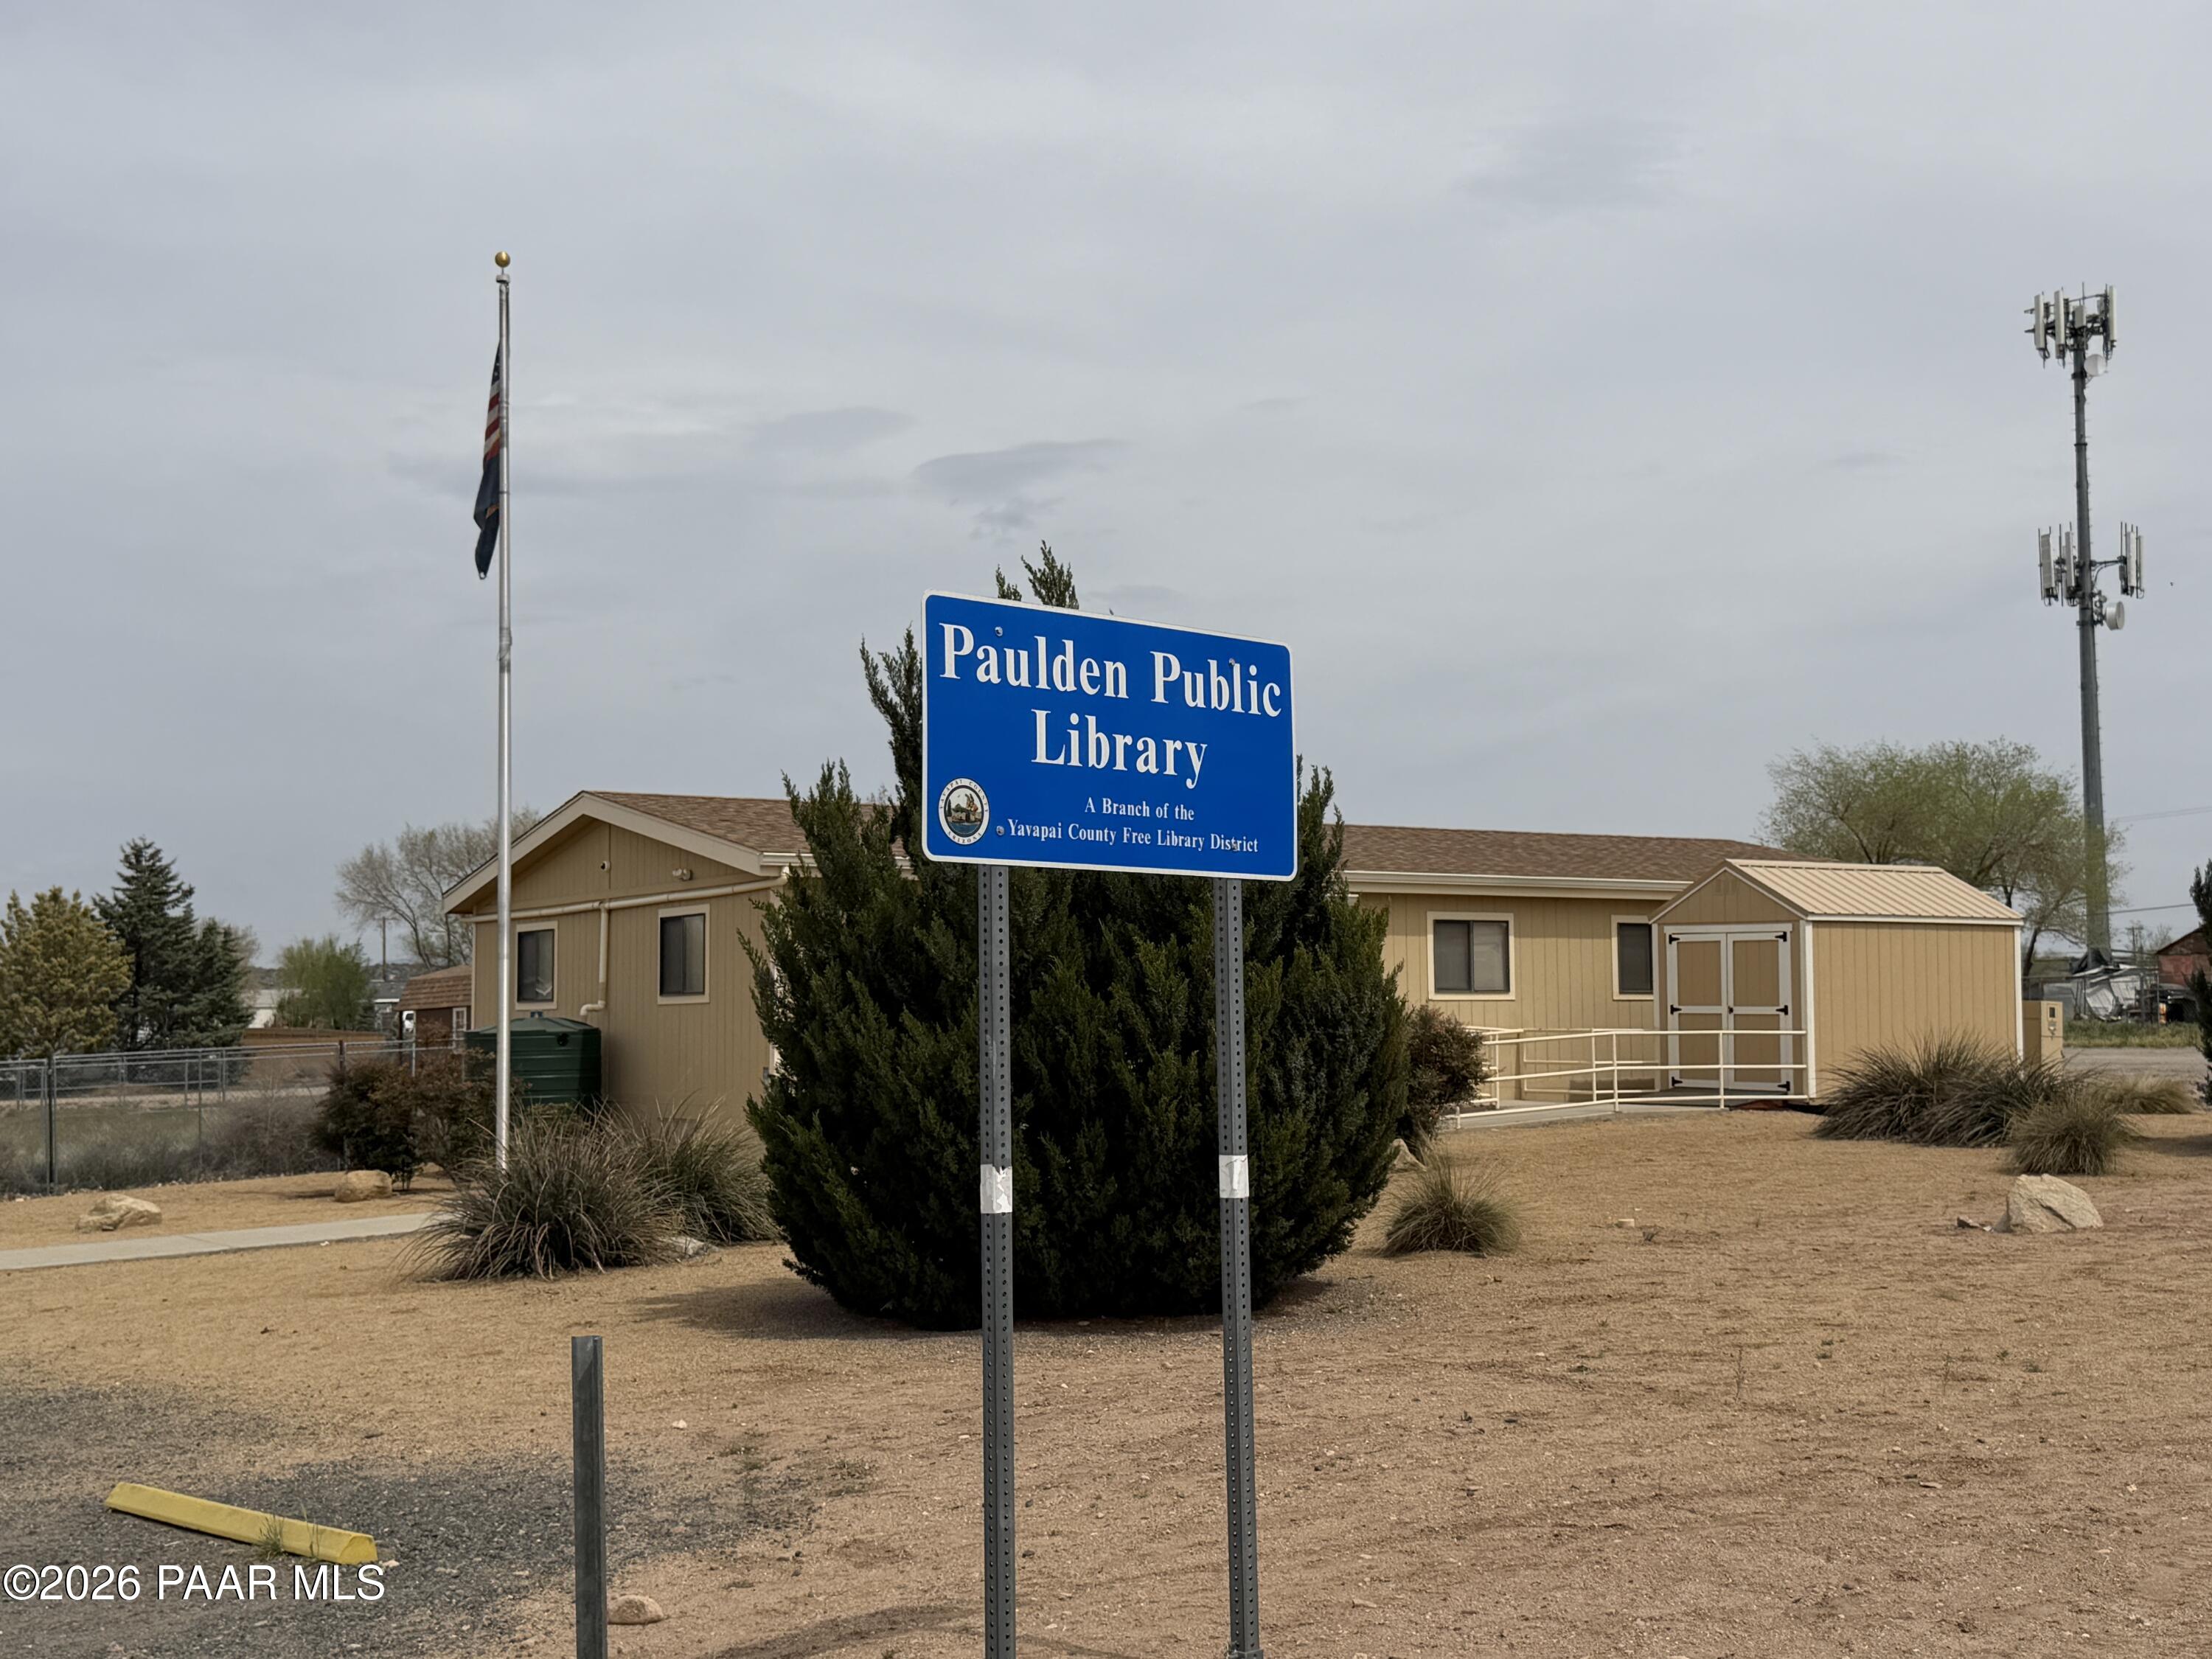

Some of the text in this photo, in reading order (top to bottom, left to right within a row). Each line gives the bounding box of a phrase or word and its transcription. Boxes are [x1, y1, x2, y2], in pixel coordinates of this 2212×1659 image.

[939, 622, 1281, 717] Paulden Public
[1031, 709, 1208, 790] Library
[1007, 818, 1062, 841] Yavapai
[1068, 823, 1117, 846] County
[1122, 827, 1152, 845] Free
[1157, 830, 1204, 852] Library
[1084, 796, 1195, 821] A Branch of the
